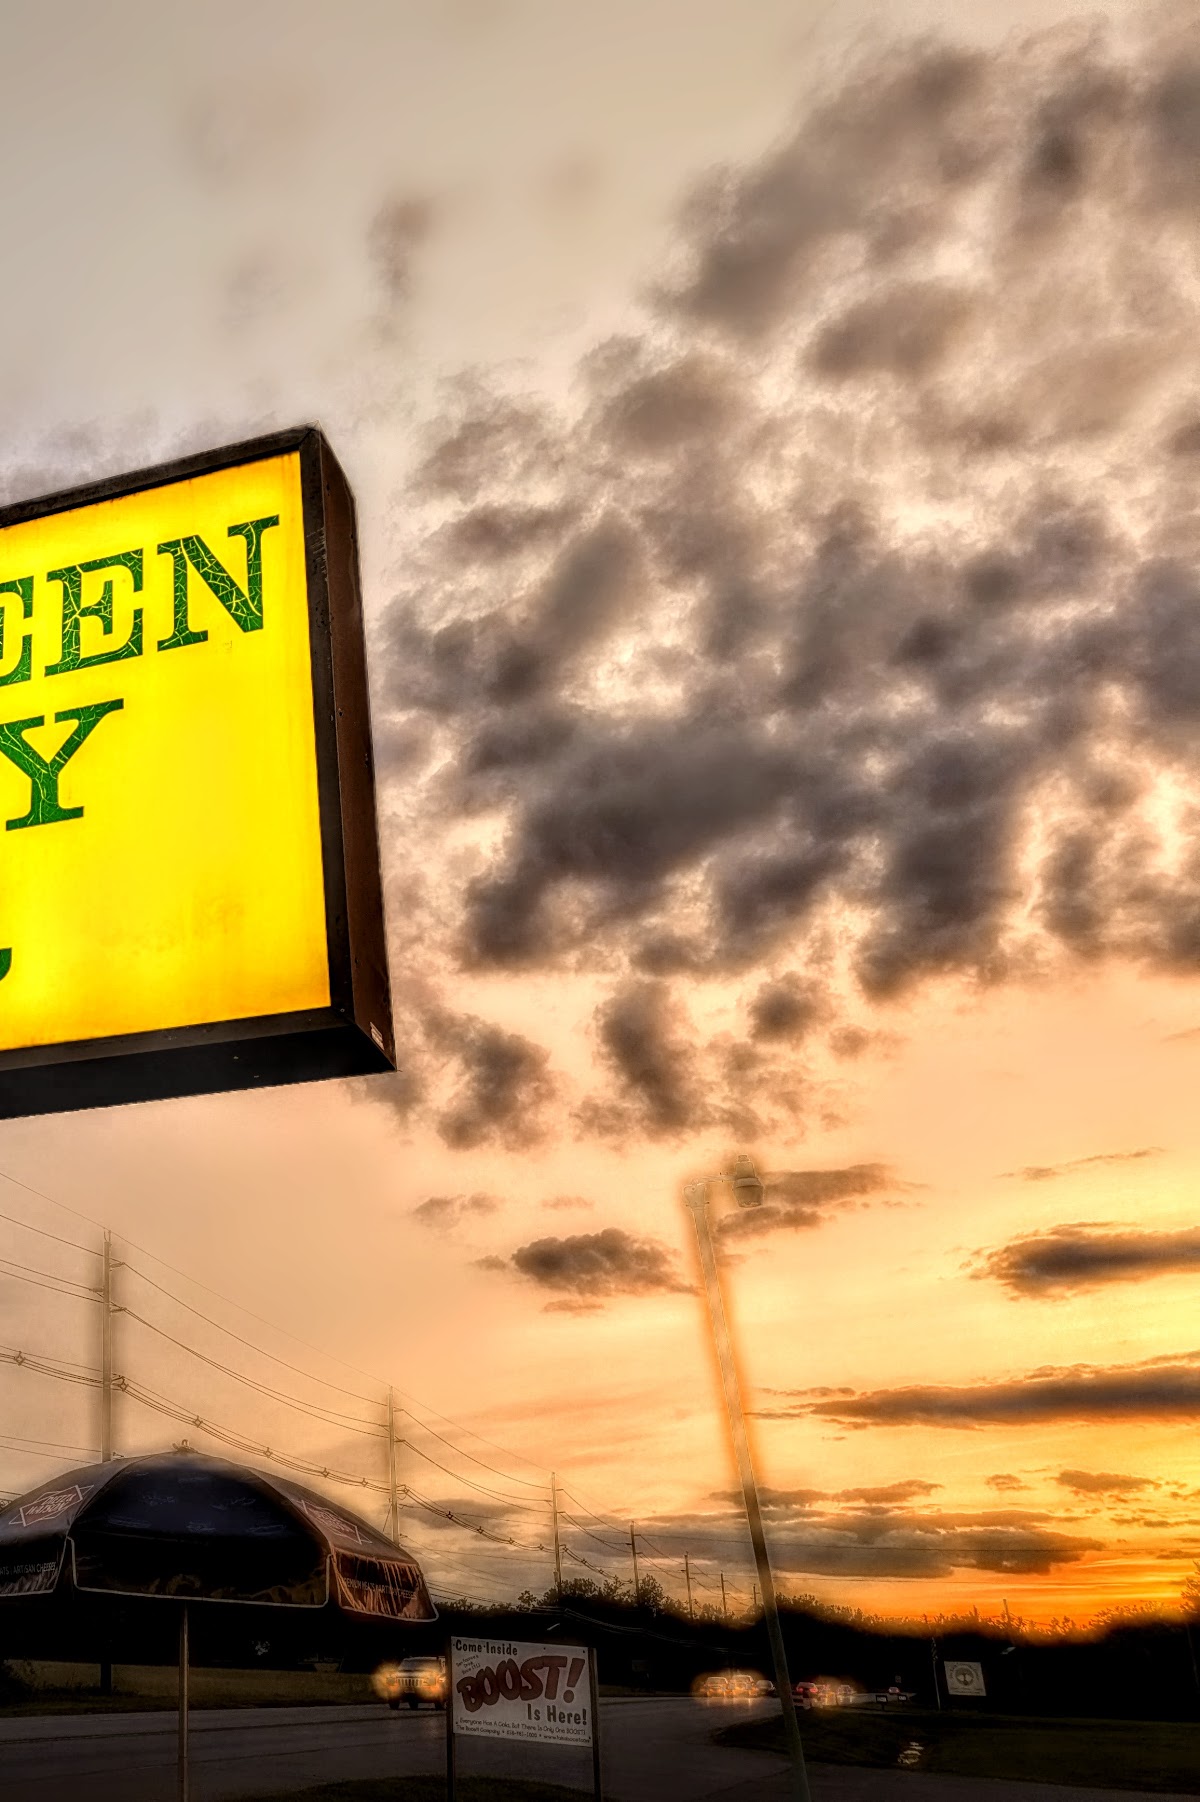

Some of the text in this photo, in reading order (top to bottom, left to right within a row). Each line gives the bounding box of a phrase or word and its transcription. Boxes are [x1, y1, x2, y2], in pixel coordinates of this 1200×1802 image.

[13, 1564, 36, 1574] ARTISAN
[455, 1639, 518, 1656] Come Inside
[456, 1655, 586, 1713] BOOST!
[527, 1703, 587, 1726] Is Here!
[459, 1717, 482, 1726] Everyone
[521, 1723, 536, 1731] There
[543, 1725, 554, 1734] Only
[480, 1727, 500, 1735] Company
